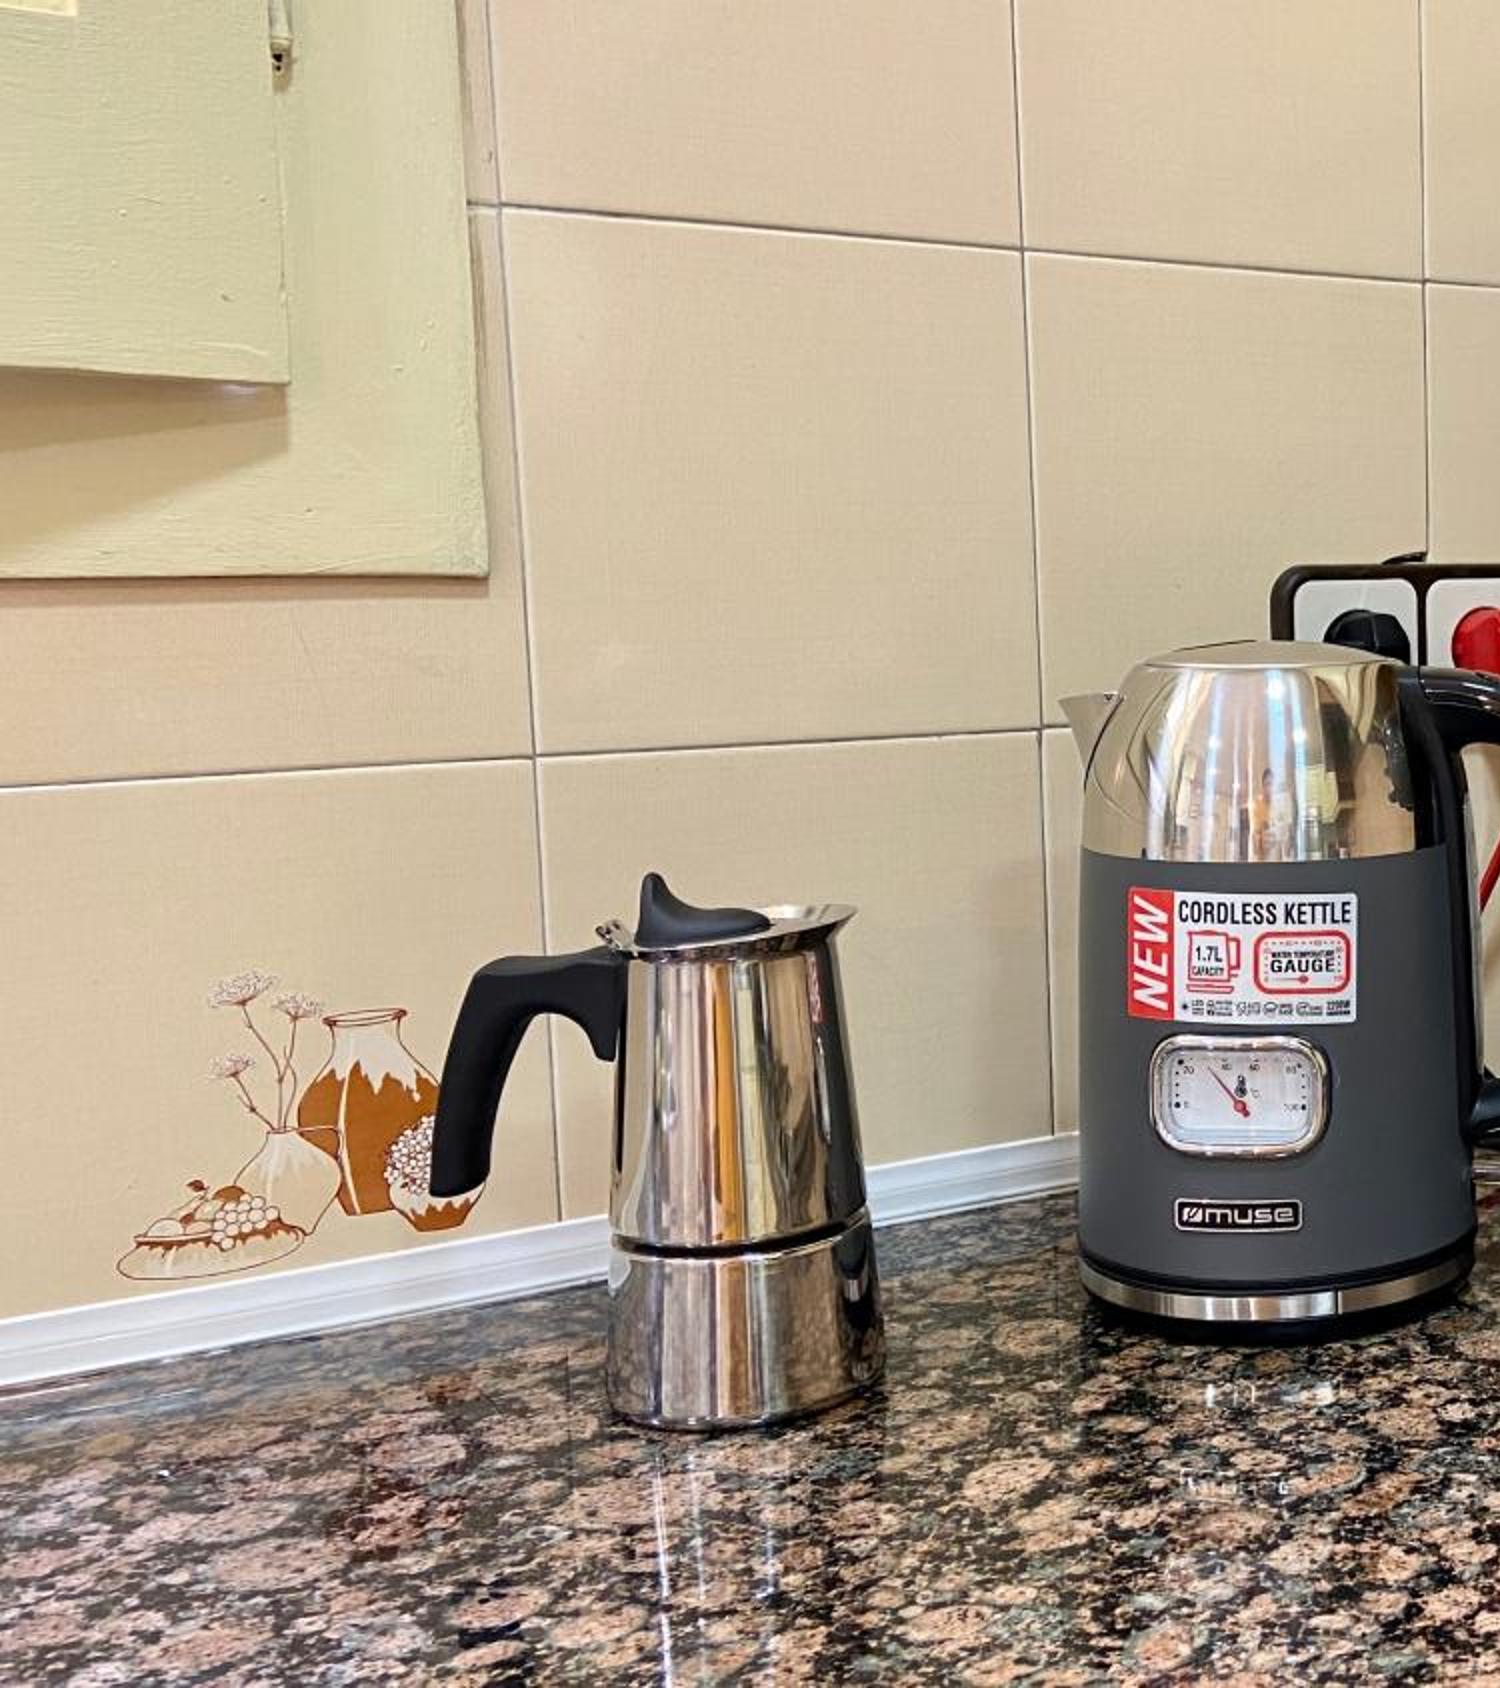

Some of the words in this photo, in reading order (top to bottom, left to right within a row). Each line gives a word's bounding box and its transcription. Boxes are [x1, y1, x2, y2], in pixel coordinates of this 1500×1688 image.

[1178, 900, 1276, 924] CORDLESS
[1284, 902, 1350, 924] KETTLE
[1133, 895, 1168, 1011] NEW
[1195, 946, 1223, 962] 1.7L
[1191, 966, 1224, 977] CAPACITY
[1270, 959, 1336, 973] GAUGE
[1205, 1207, 1294, 1224] muse
